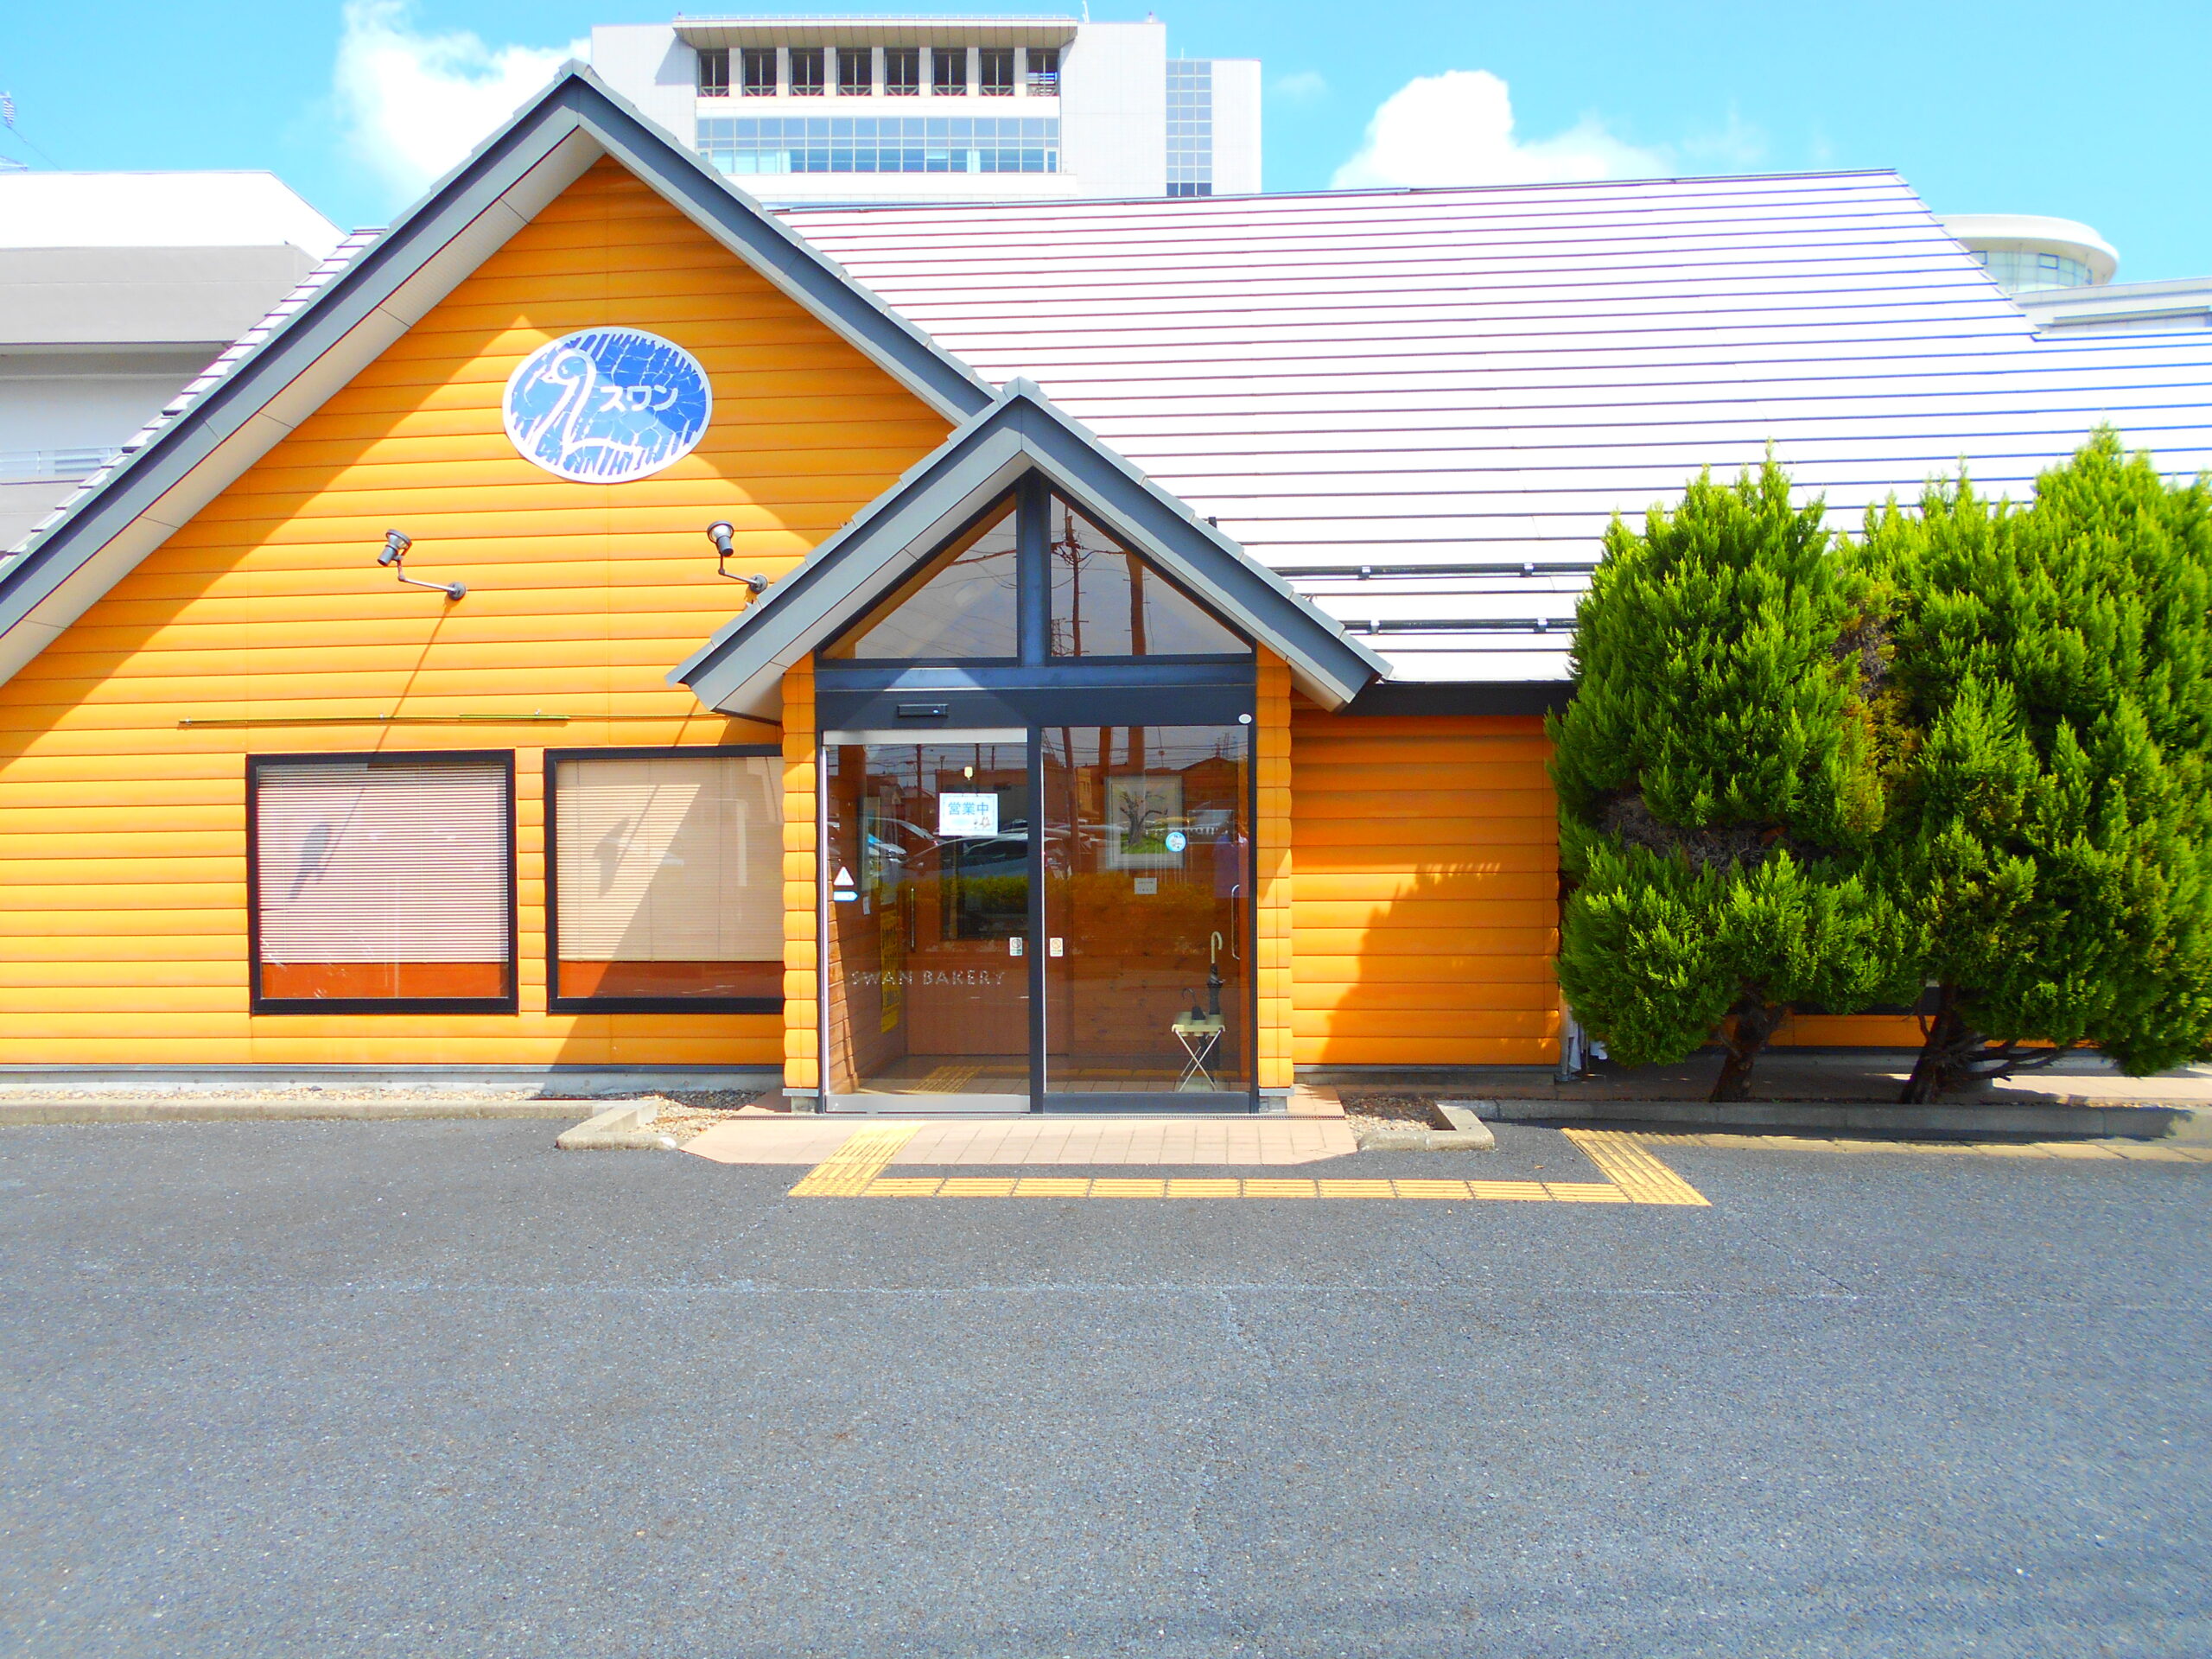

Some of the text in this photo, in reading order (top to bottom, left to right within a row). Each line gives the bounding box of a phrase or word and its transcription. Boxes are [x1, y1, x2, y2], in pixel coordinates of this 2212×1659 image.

[600, 385, 678, 412] スワン
[947, 801, 989, 817] 営業中
[850, 970, 1007, 986] SWAN BAKERY
